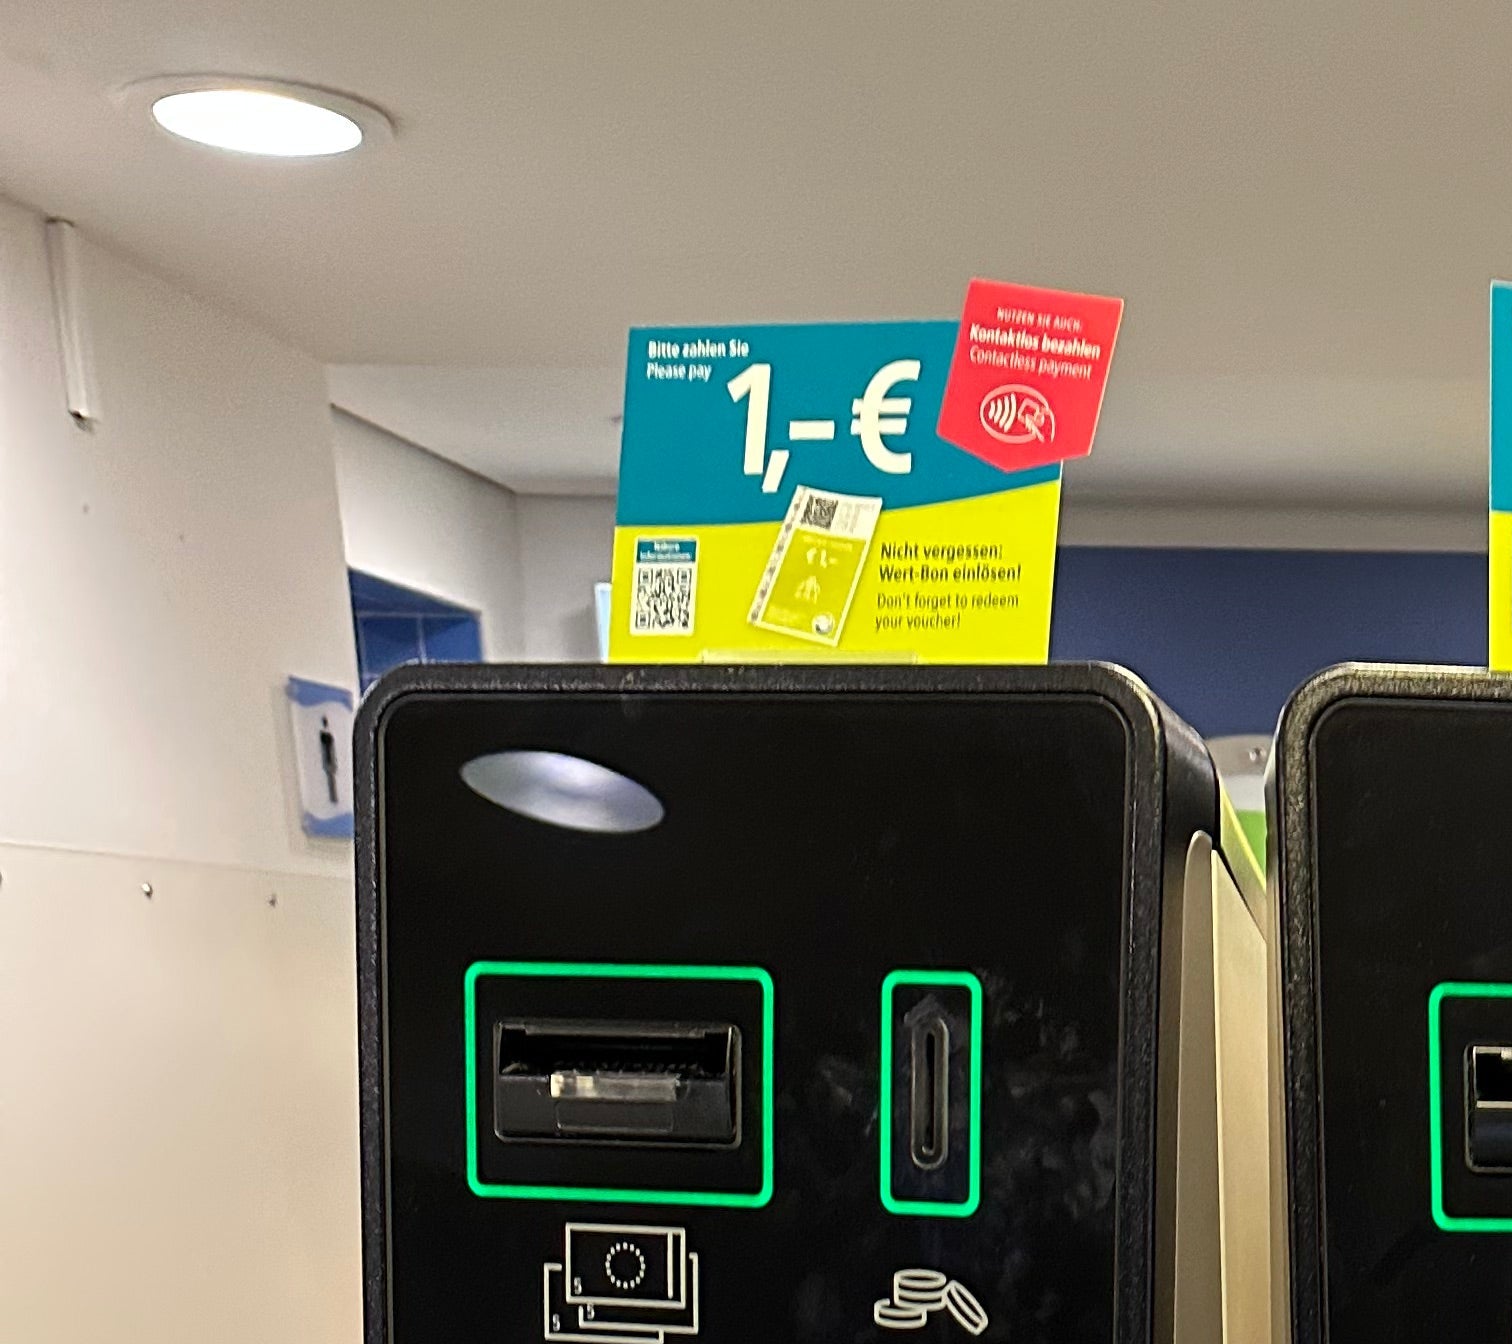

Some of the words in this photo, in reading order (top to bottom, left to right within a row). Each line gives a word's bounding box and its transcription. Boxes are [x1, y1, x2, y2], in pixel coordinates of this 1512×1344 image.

[997, 307, 1034, 326] NUTZEN
[1037, 312, 1052, 328] SIE
[649, 340, 680, 358] Bitte
[682, 339, 726, 358] zahlen
[729, 339, 749, 358] Sie
[970, 322, 1039, 350] Kontaktlos
[1042, 332, 1100, 360] bezahlen
[647, 362, 686, 380] Please
[688, 364, 712, 382] pay
[970, 345, 1036, 372] Contactless
[1038, 357, 1092, 380] payment
[850, 359, 921, 474] €
[881, 540, 918, 559] Nicht
[880, 564, 948, 582] Wert-Bon
[953, 562, 1021, 582] einlösen!
[877, 592, 910, 609] Don't
[915, 592, 950, 612] forget
[956, 593, 968, 608] to
[972, 592, 1018, 608] redeem
[876, 615, 902, 634] your
[907, 612, 960, 630] voucher!
